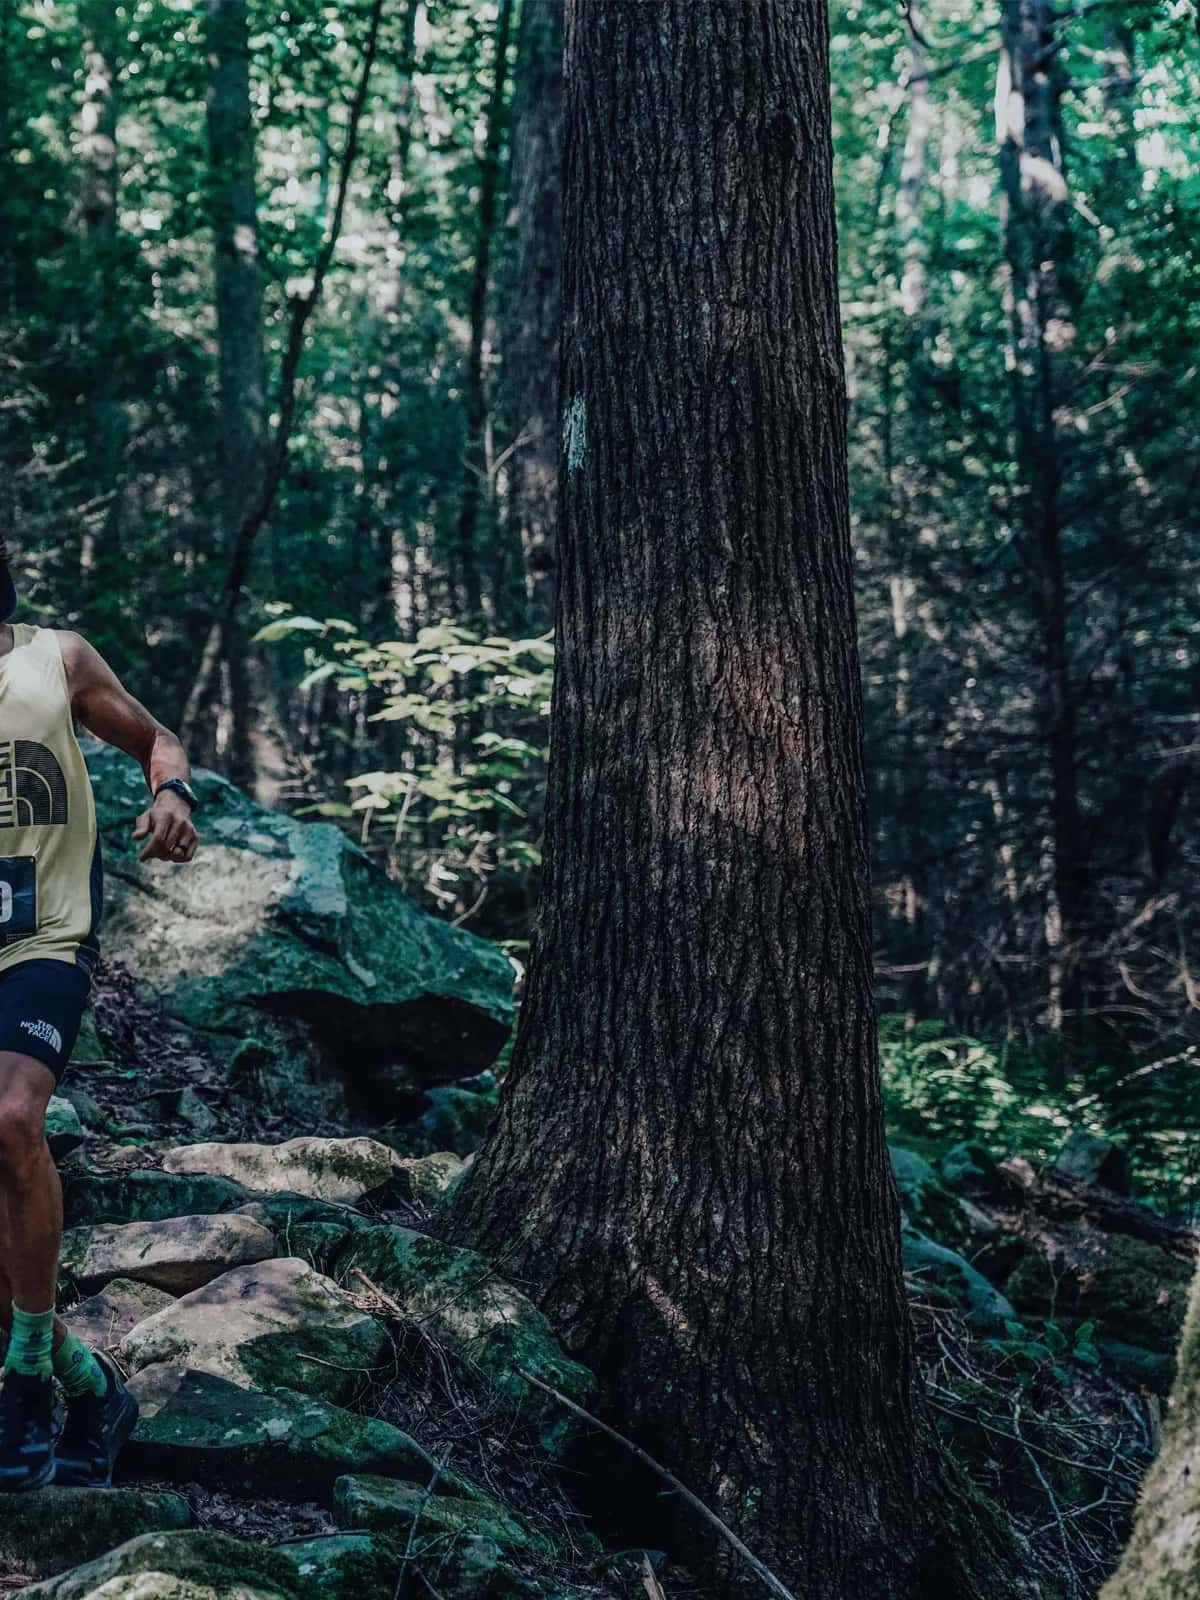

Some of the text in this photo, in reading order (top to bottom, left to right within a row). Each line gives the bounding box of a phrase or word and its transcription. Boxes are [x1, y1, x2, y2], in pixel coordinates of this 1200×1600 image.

[20, 1020, 52, 1035] NORTH
[38, 1019, 54, 1029] THE
[28, 1030, 50, 1042] FACE
